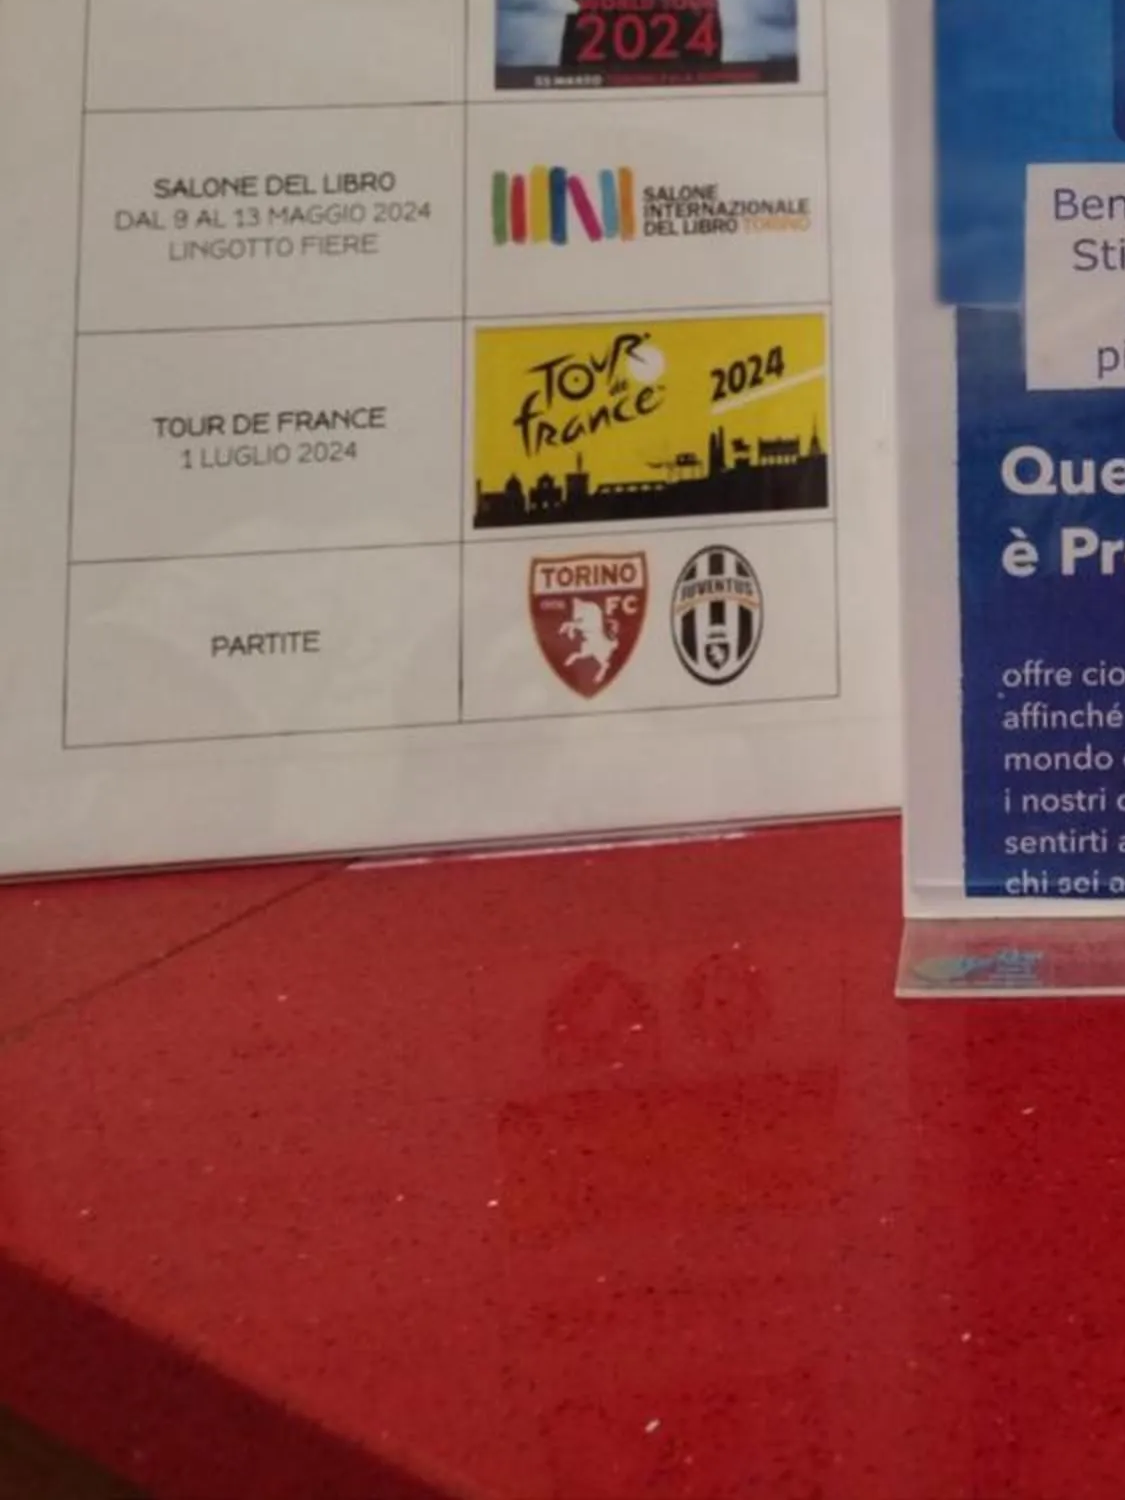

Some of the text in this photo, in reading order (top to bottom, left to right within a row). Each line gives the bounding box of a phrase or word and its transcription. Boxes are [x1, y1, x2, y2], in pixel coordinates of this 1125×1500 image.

[576, 14, 718, 62] 2024
[153, 171, 396, 200] SALONE DEL LIBRO
[643, 184, 718, 202] SALONE
[114, 209, 166, 232] DAL
[195, 209, 225, 229] AL
[233, 206, 261, 229] 13
[267, 202, 366, 226] MAGGIO
[372, 200, 432, 224] 2024
[643, 198, 810, 217] INTERNAZIONALE
[644, 215, 810, 237] DEL LIBRO TORINO
[168, 232, 378, 262] LINGOTTO FIERE
[526, 333, 645, 407] TOUR
[710, 345, 785, 402] 2024
[152, 406, 386, 439] TOUR DE FRANCE
[182, 440, 358, 470] 1 LUGLIO 2024
[1001, 527, 1039, 578] è
[540, 563, 637, 589] TORINO
[605, 597, 639, 615] FC
[210, 630, 321, 657] PARTITE
[1001, 659, 1073, 688] offre
[1002, 701, 1124, 730] affinché
[1004, 742, 1114, 771] mondo
[1004, 787, 1011, 813] i
[1022, 787, 1106, 813] nostri
[1004, 828, 1108, 855] sentirti
[1004, 868, 1049, 894] chi
